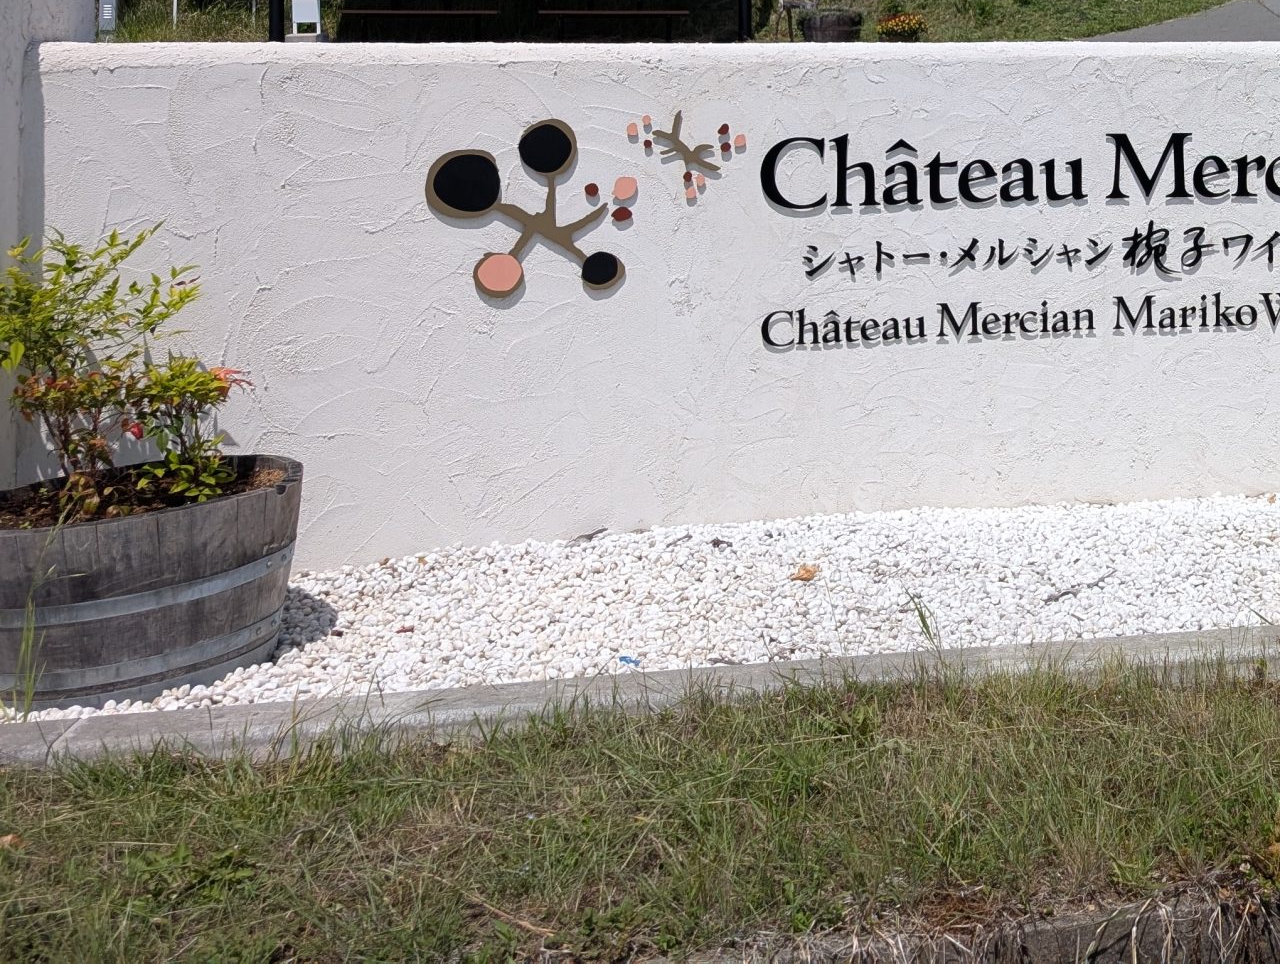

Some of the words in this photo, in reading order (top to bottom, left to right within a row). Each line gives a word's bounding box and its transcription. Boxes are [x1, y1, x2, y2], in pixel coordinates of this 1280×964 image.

[760, 133, 1088, 210] Château
[761, 308, 927, 347] Château
[937, 300, 1095, 337] Mercian
